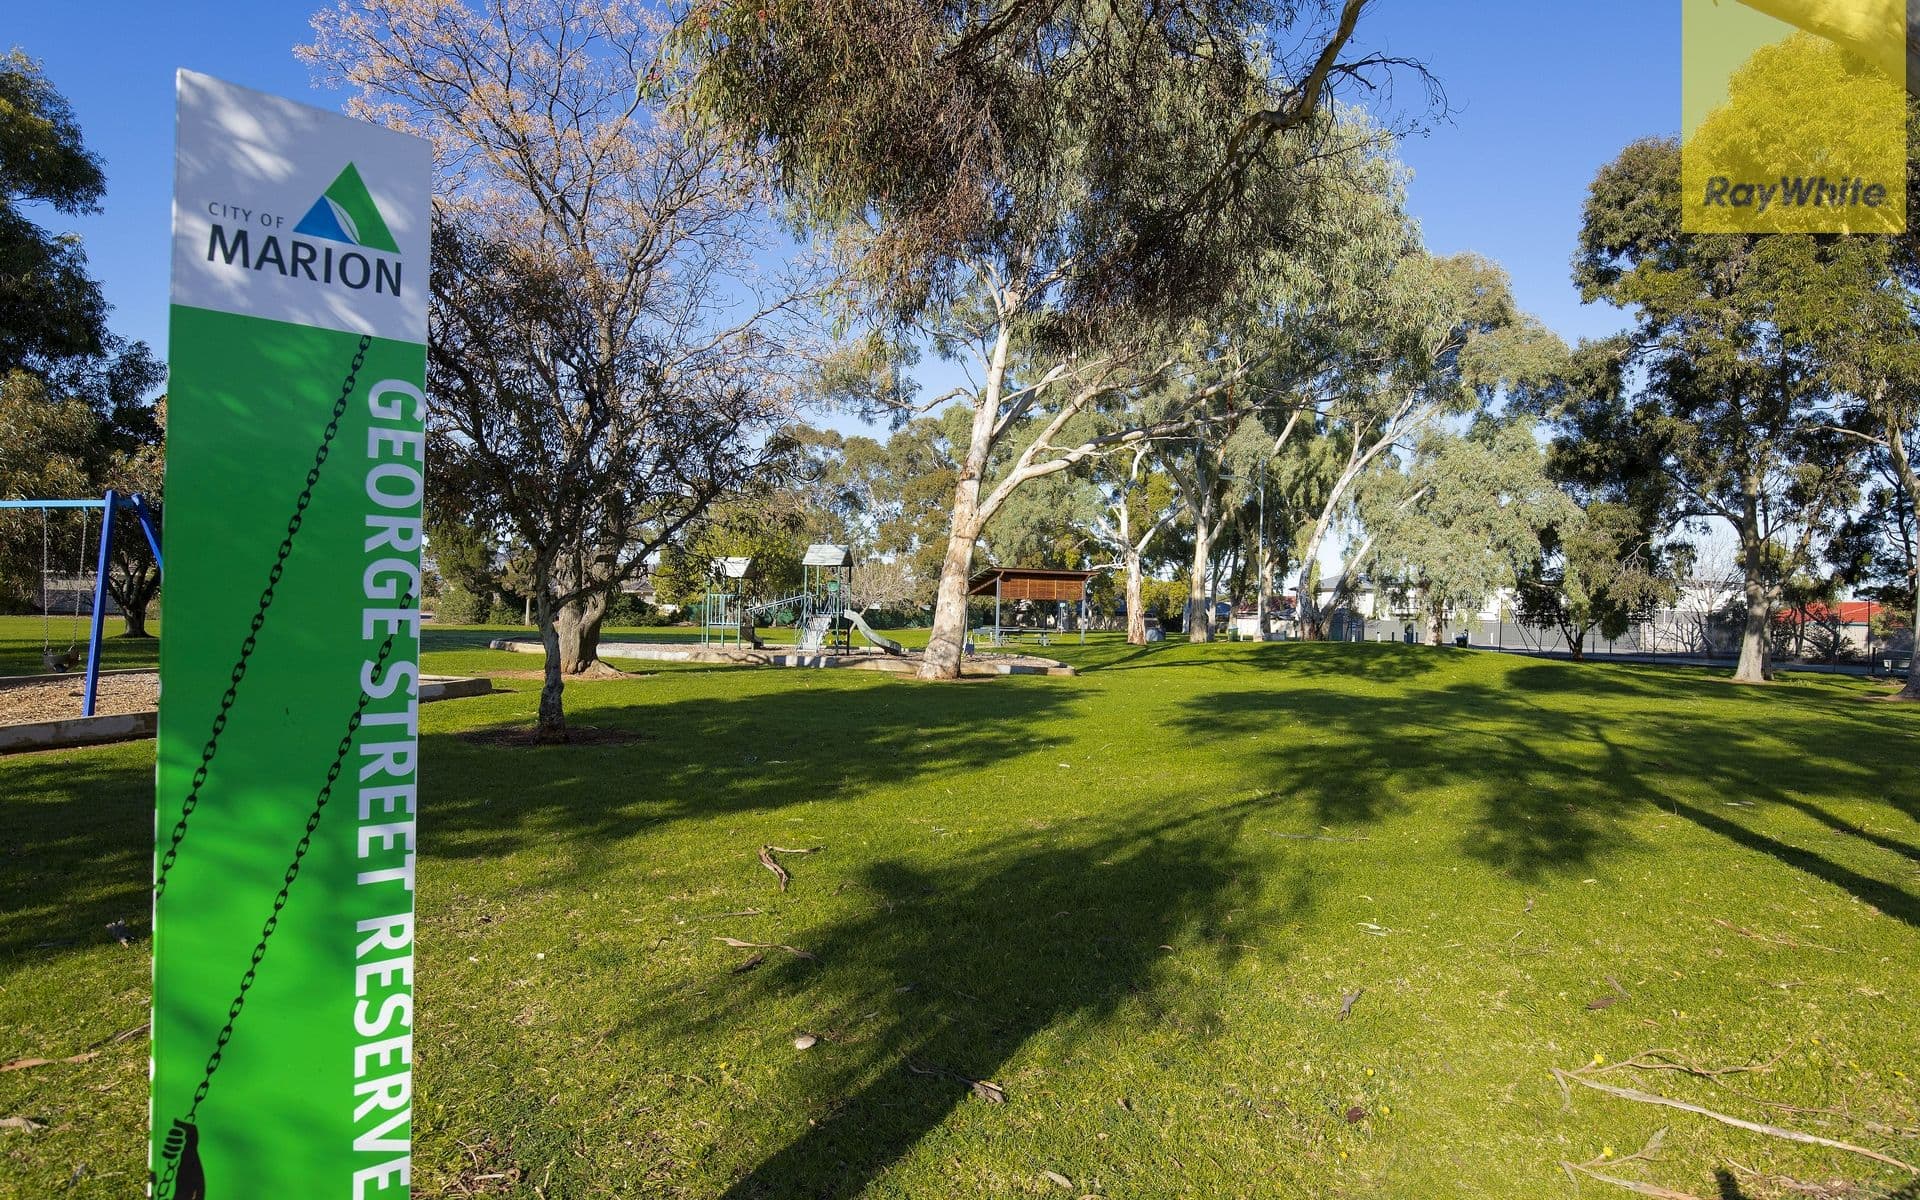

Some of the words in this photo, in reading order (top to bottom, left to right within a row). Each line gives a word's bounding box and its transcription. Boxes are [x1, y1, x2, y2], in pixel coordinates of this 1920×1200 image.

[207, 223, 402, 297] MARION
[208, 201, 253, 222] CITY
[260, 213, 284, 228] OF
[362, 378, 426, 641] GEORGE
[356, 659, 419, 891] STREET
[353, 911, 416, 1200] RESERVE
